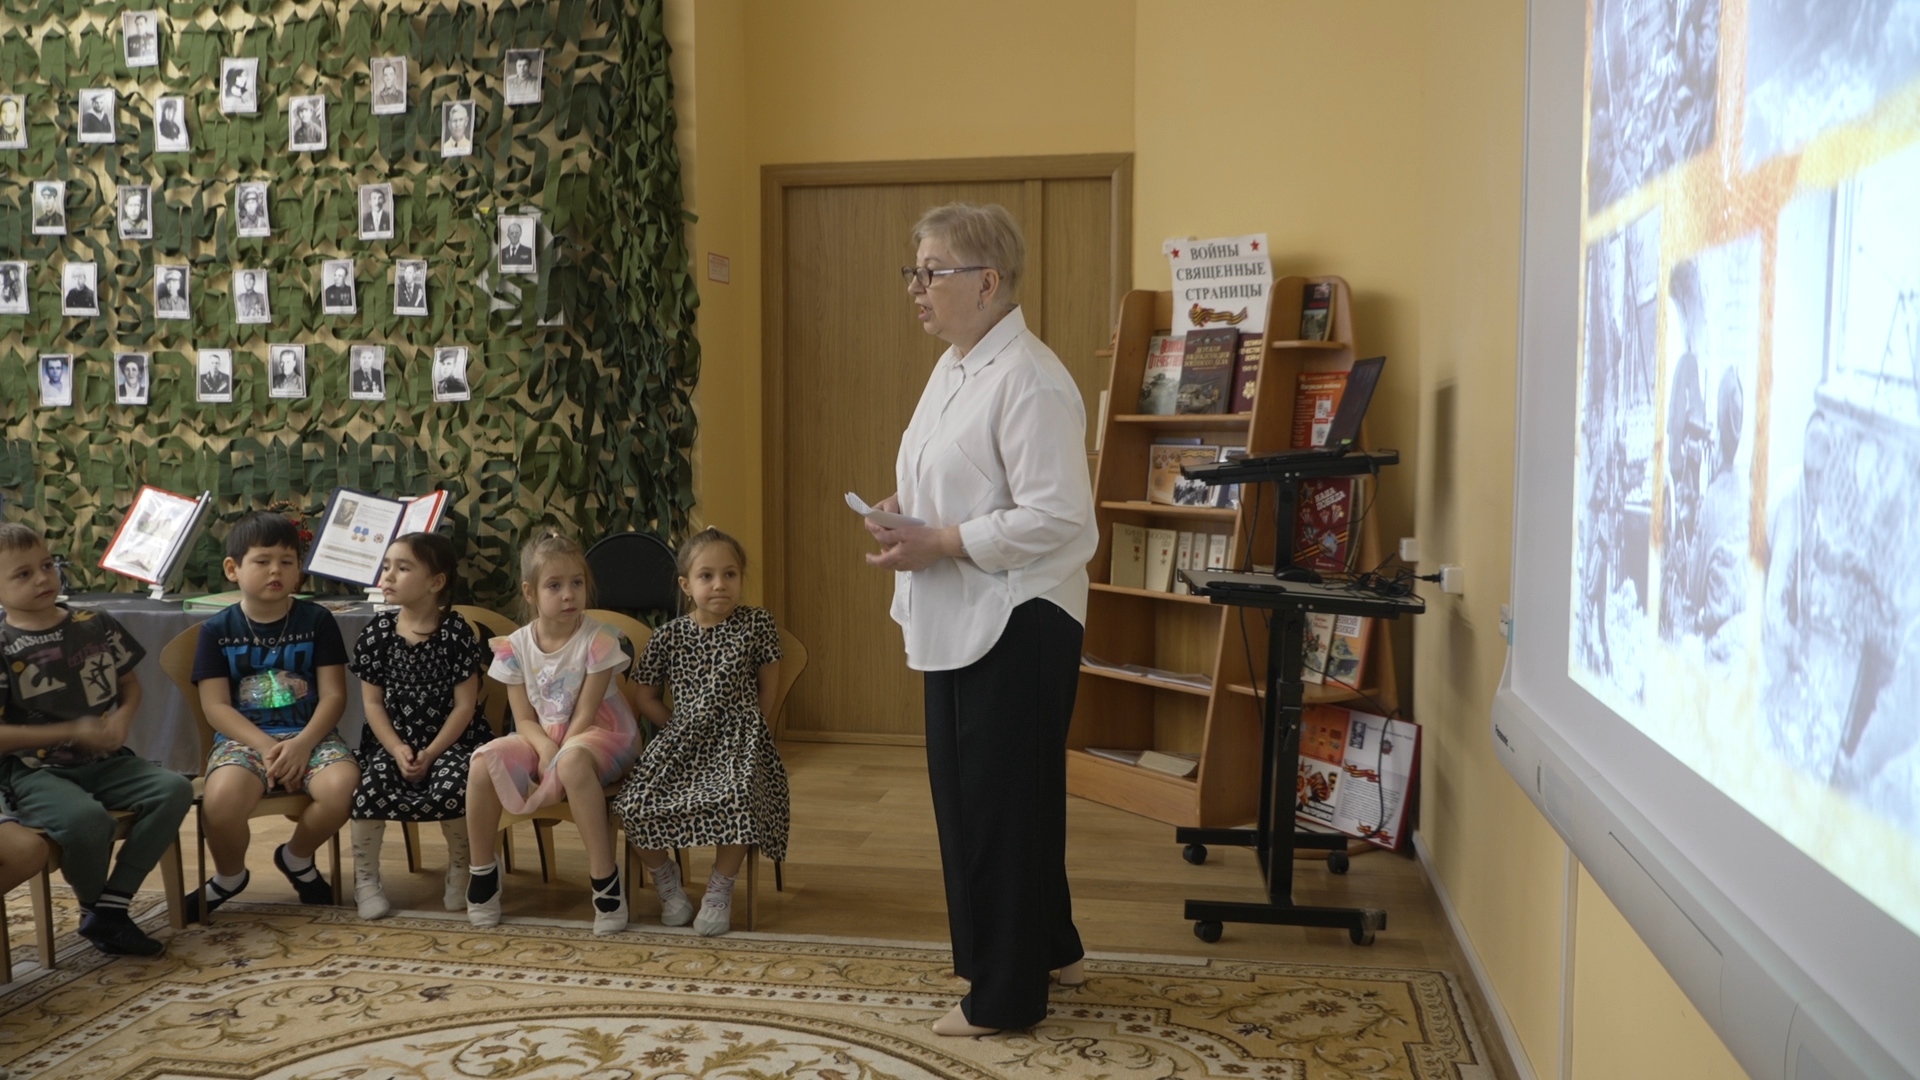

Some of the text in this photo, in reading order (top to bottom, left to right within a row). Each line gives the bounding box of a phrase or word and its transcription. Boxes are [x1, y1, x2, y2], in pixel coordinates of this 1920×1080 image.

[1190, 243, 1240, 260] ВОЙНЫ
[1176, 262, 1266, 281] СВЯЩЕННЫЕ
[1185, 284, 1262, 301] СТРАНИЦЫ
[1316, 491, 1346, 511] ПОБЕДА
[3, 629, 64, 655] SUNSHINE
